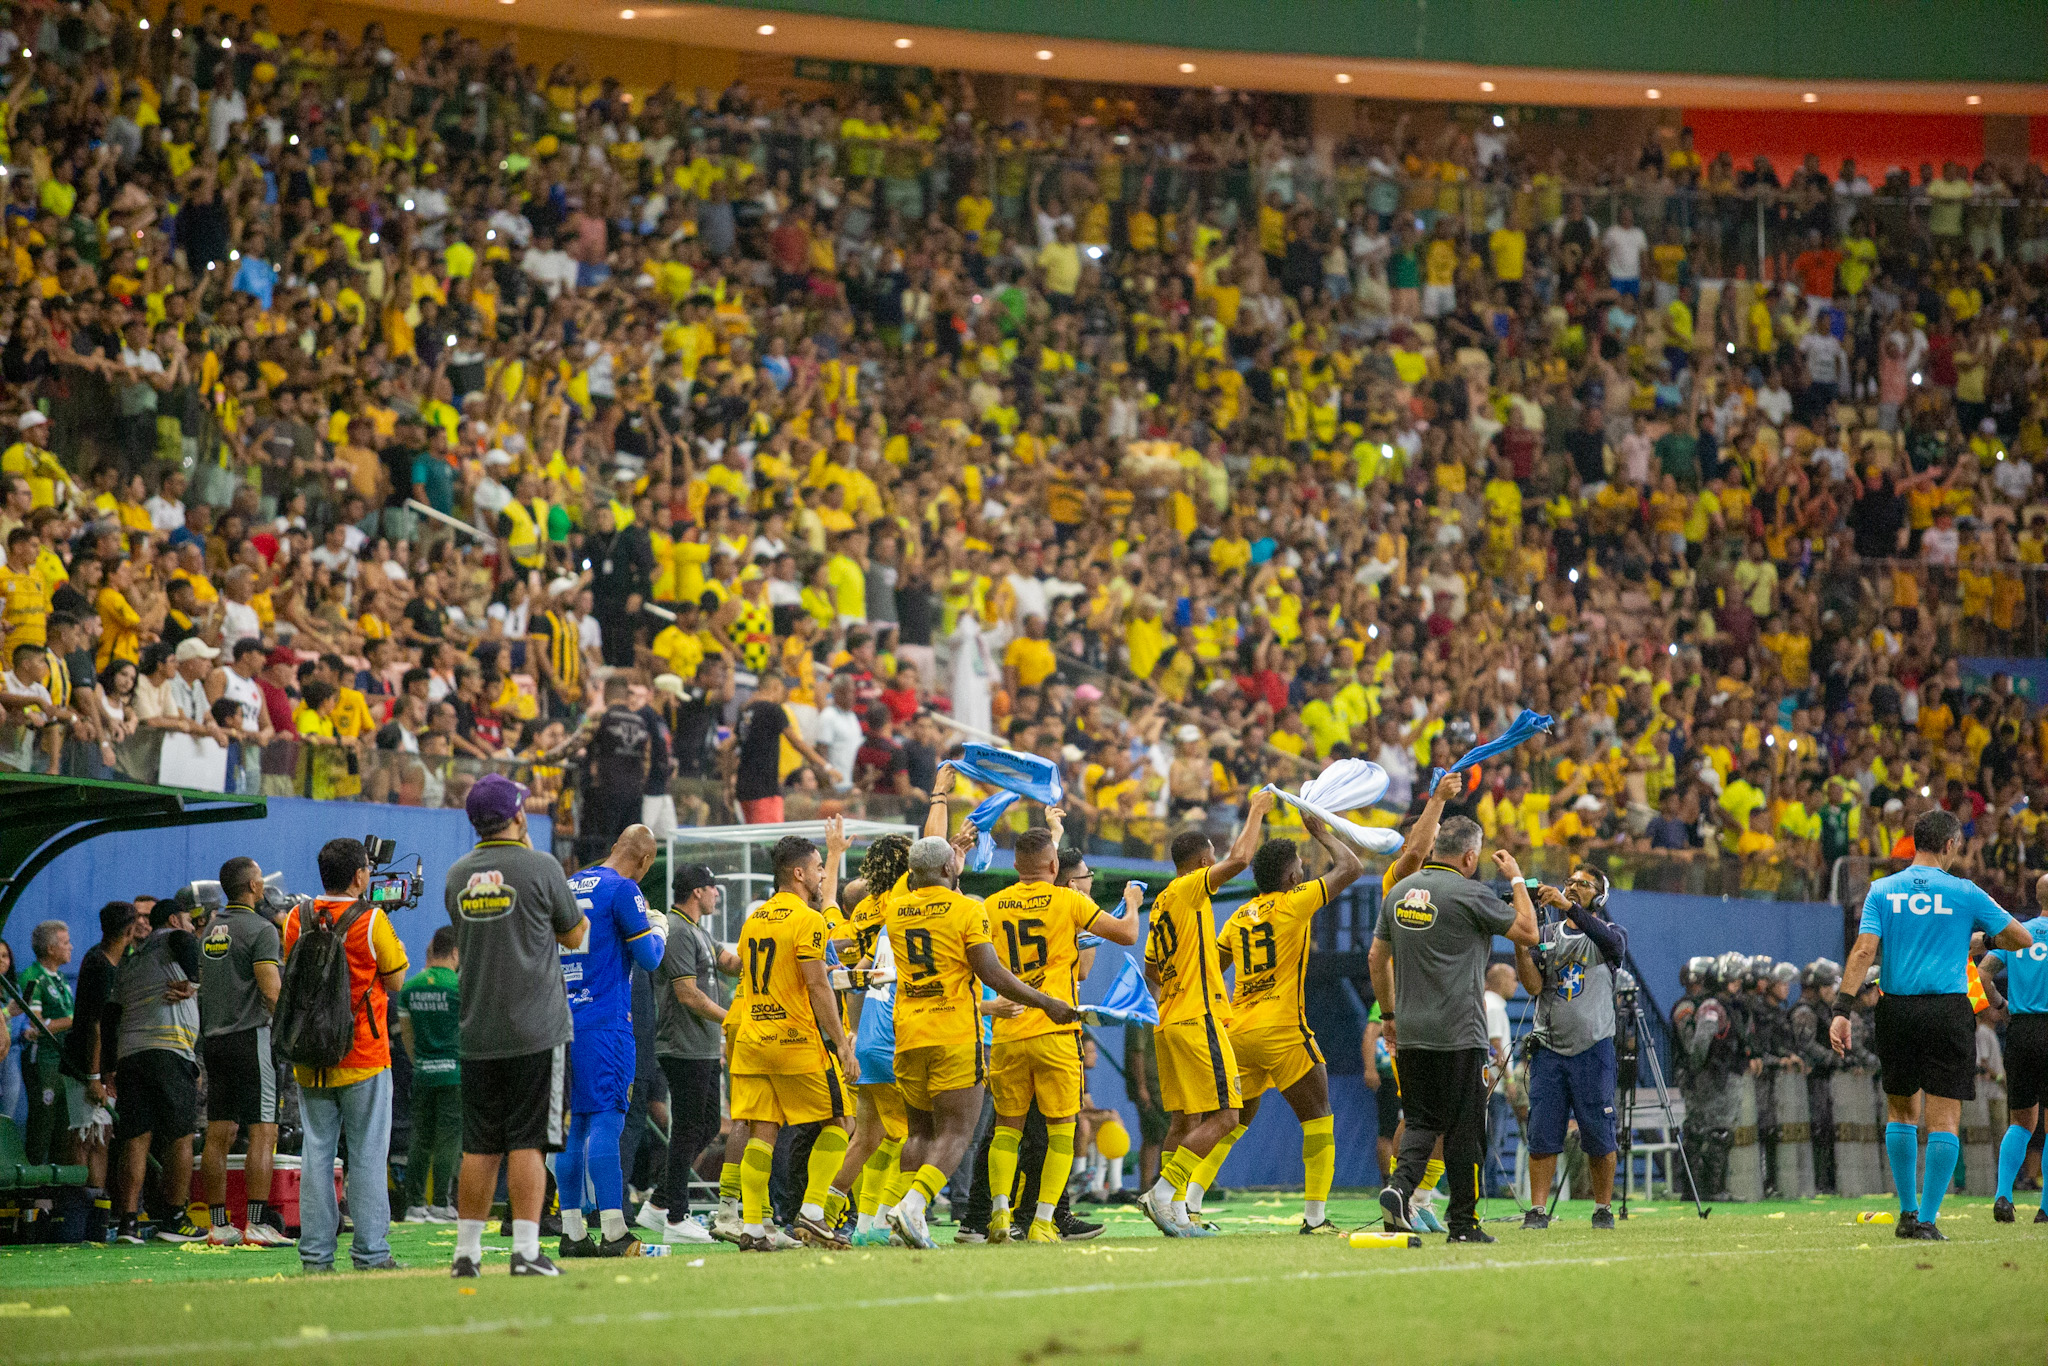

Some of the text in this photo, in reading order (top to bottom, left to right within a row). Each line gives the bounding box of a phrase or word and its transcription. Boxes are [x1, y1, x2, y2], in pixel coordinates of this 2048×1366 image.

[1886, 893, 1953, 915] TCL
[747, 937, 777, 996] 17
[904, 927, 938, 982] 9
[1002, 918, 1048, 975] 15
[1239, 922, 1277, 976] 13
